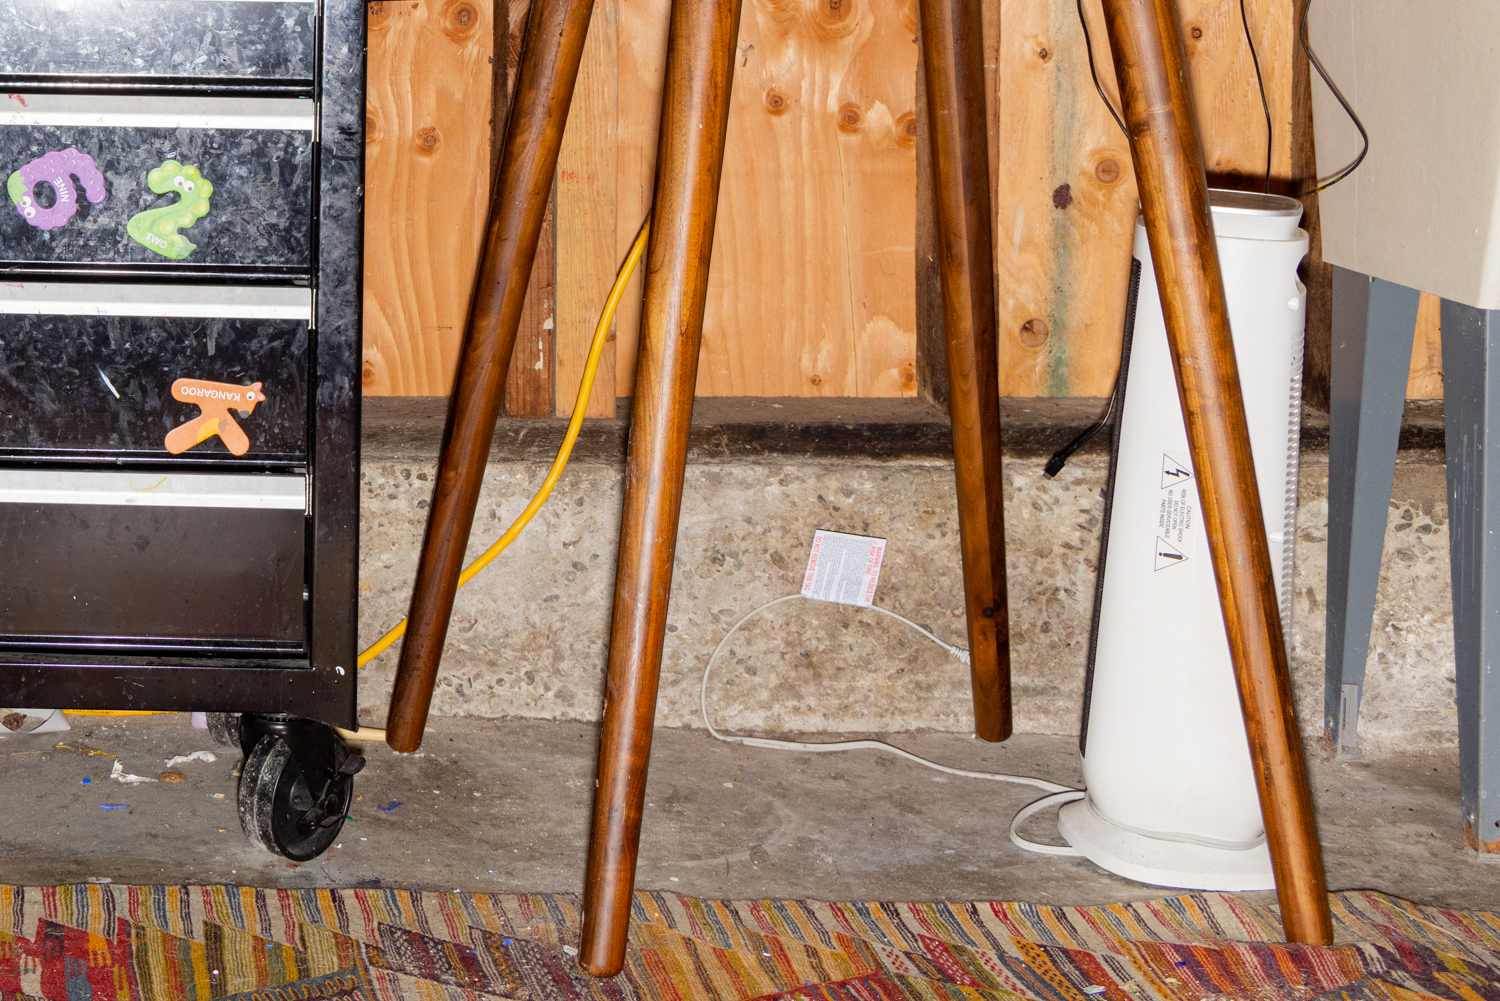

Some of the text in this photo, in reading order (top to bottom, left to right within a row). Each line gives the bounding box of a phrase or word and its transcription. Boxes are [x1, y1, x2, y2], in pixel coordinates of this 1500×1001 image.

[53, 174, 70, 202] NINE
[145, 231, 168, 250] TWO
[180, 386, 241, 402] KANGAROO
[808, 553, 818, 572] REMOVE
[806, 572, 814, 581] THIS
